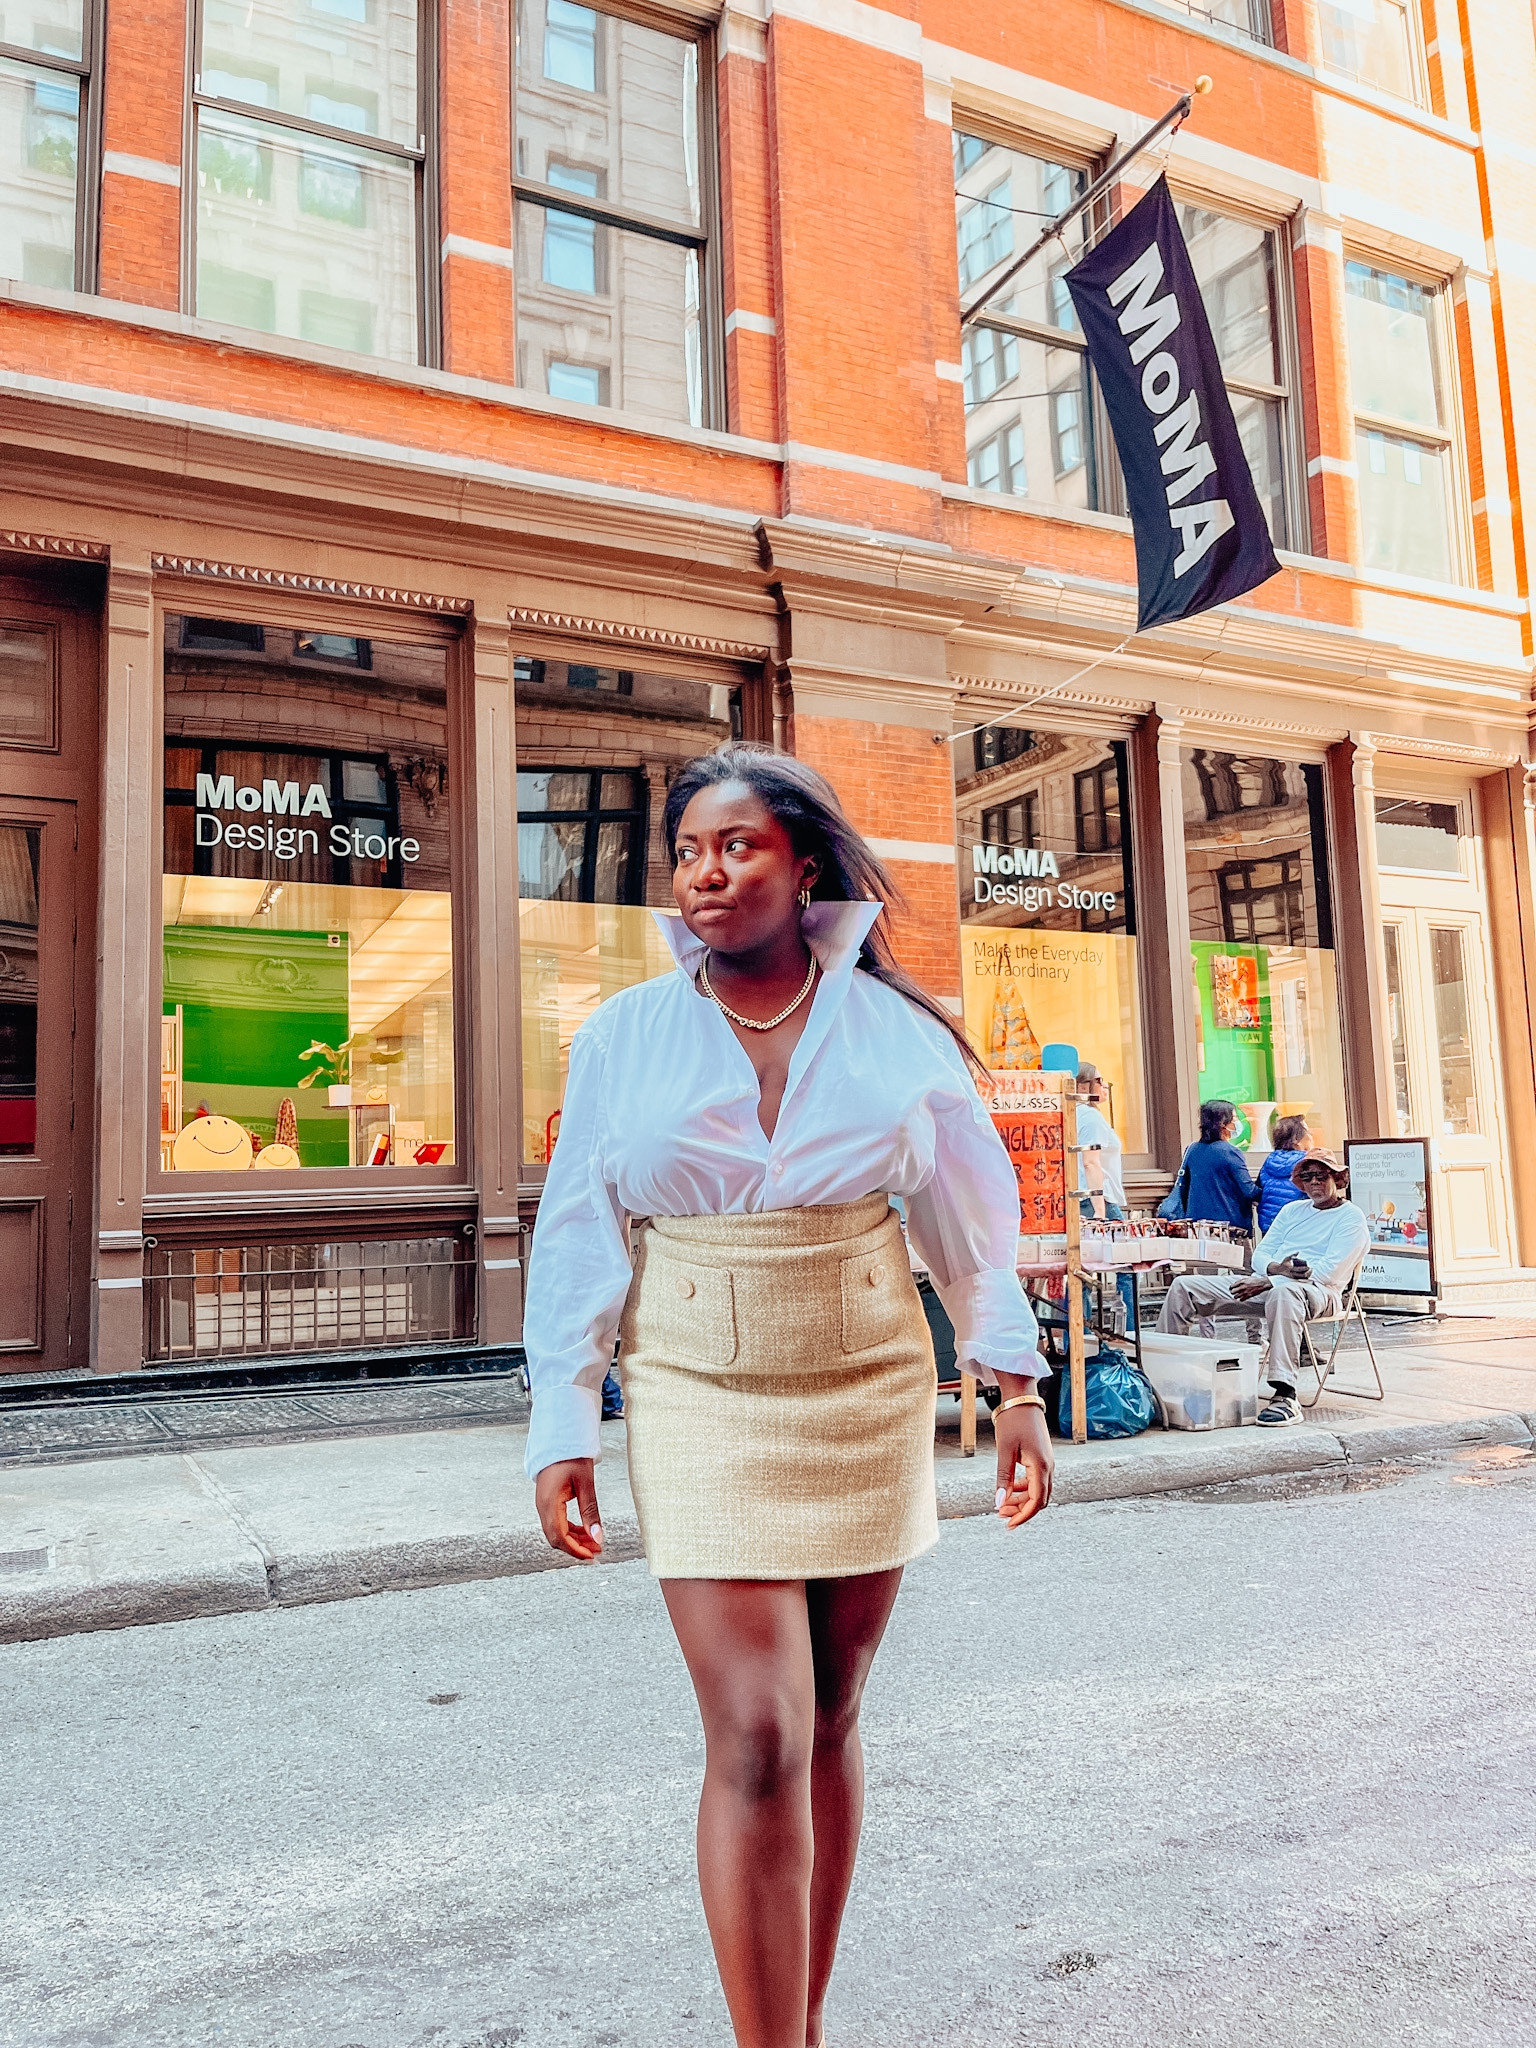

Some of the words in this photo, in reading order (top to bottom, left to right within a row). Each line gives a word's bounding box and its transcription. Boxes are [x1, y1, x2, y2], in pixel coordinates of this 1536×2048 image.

[1106, 241, 1236, 579] MoMA
[196, 773, 332, 818] MoMA
[196, 813, 318, 860] Design
[328, 825, 420, 862] Store
[972, 845, 1060, 879] MoMA
[973, 877, 1053, 912] Design
[1057, 882, 1116, 912] Store
[974, 942, 1011, 958] Make
[1015, 944, 1038, 960] the
[1042, 945, 1104, 967] Everyday
[974, 961, 1071, 983] Extraordinary
[1014, 1097, 1058, 1111] GLASSES
[1354, 1151, 1416, 1161] Curator-approved
[1355, 1161, 1381, 1170] designs
[1381, 1160, 1391, 1168] for
[1355, 1170, 1386, 1179] everyday
[1361, 1265, 1385, 1274] MoMA
[1361, 1274, 1384, 1284] Design
[1384, 1275, 1402, 1283] Store
